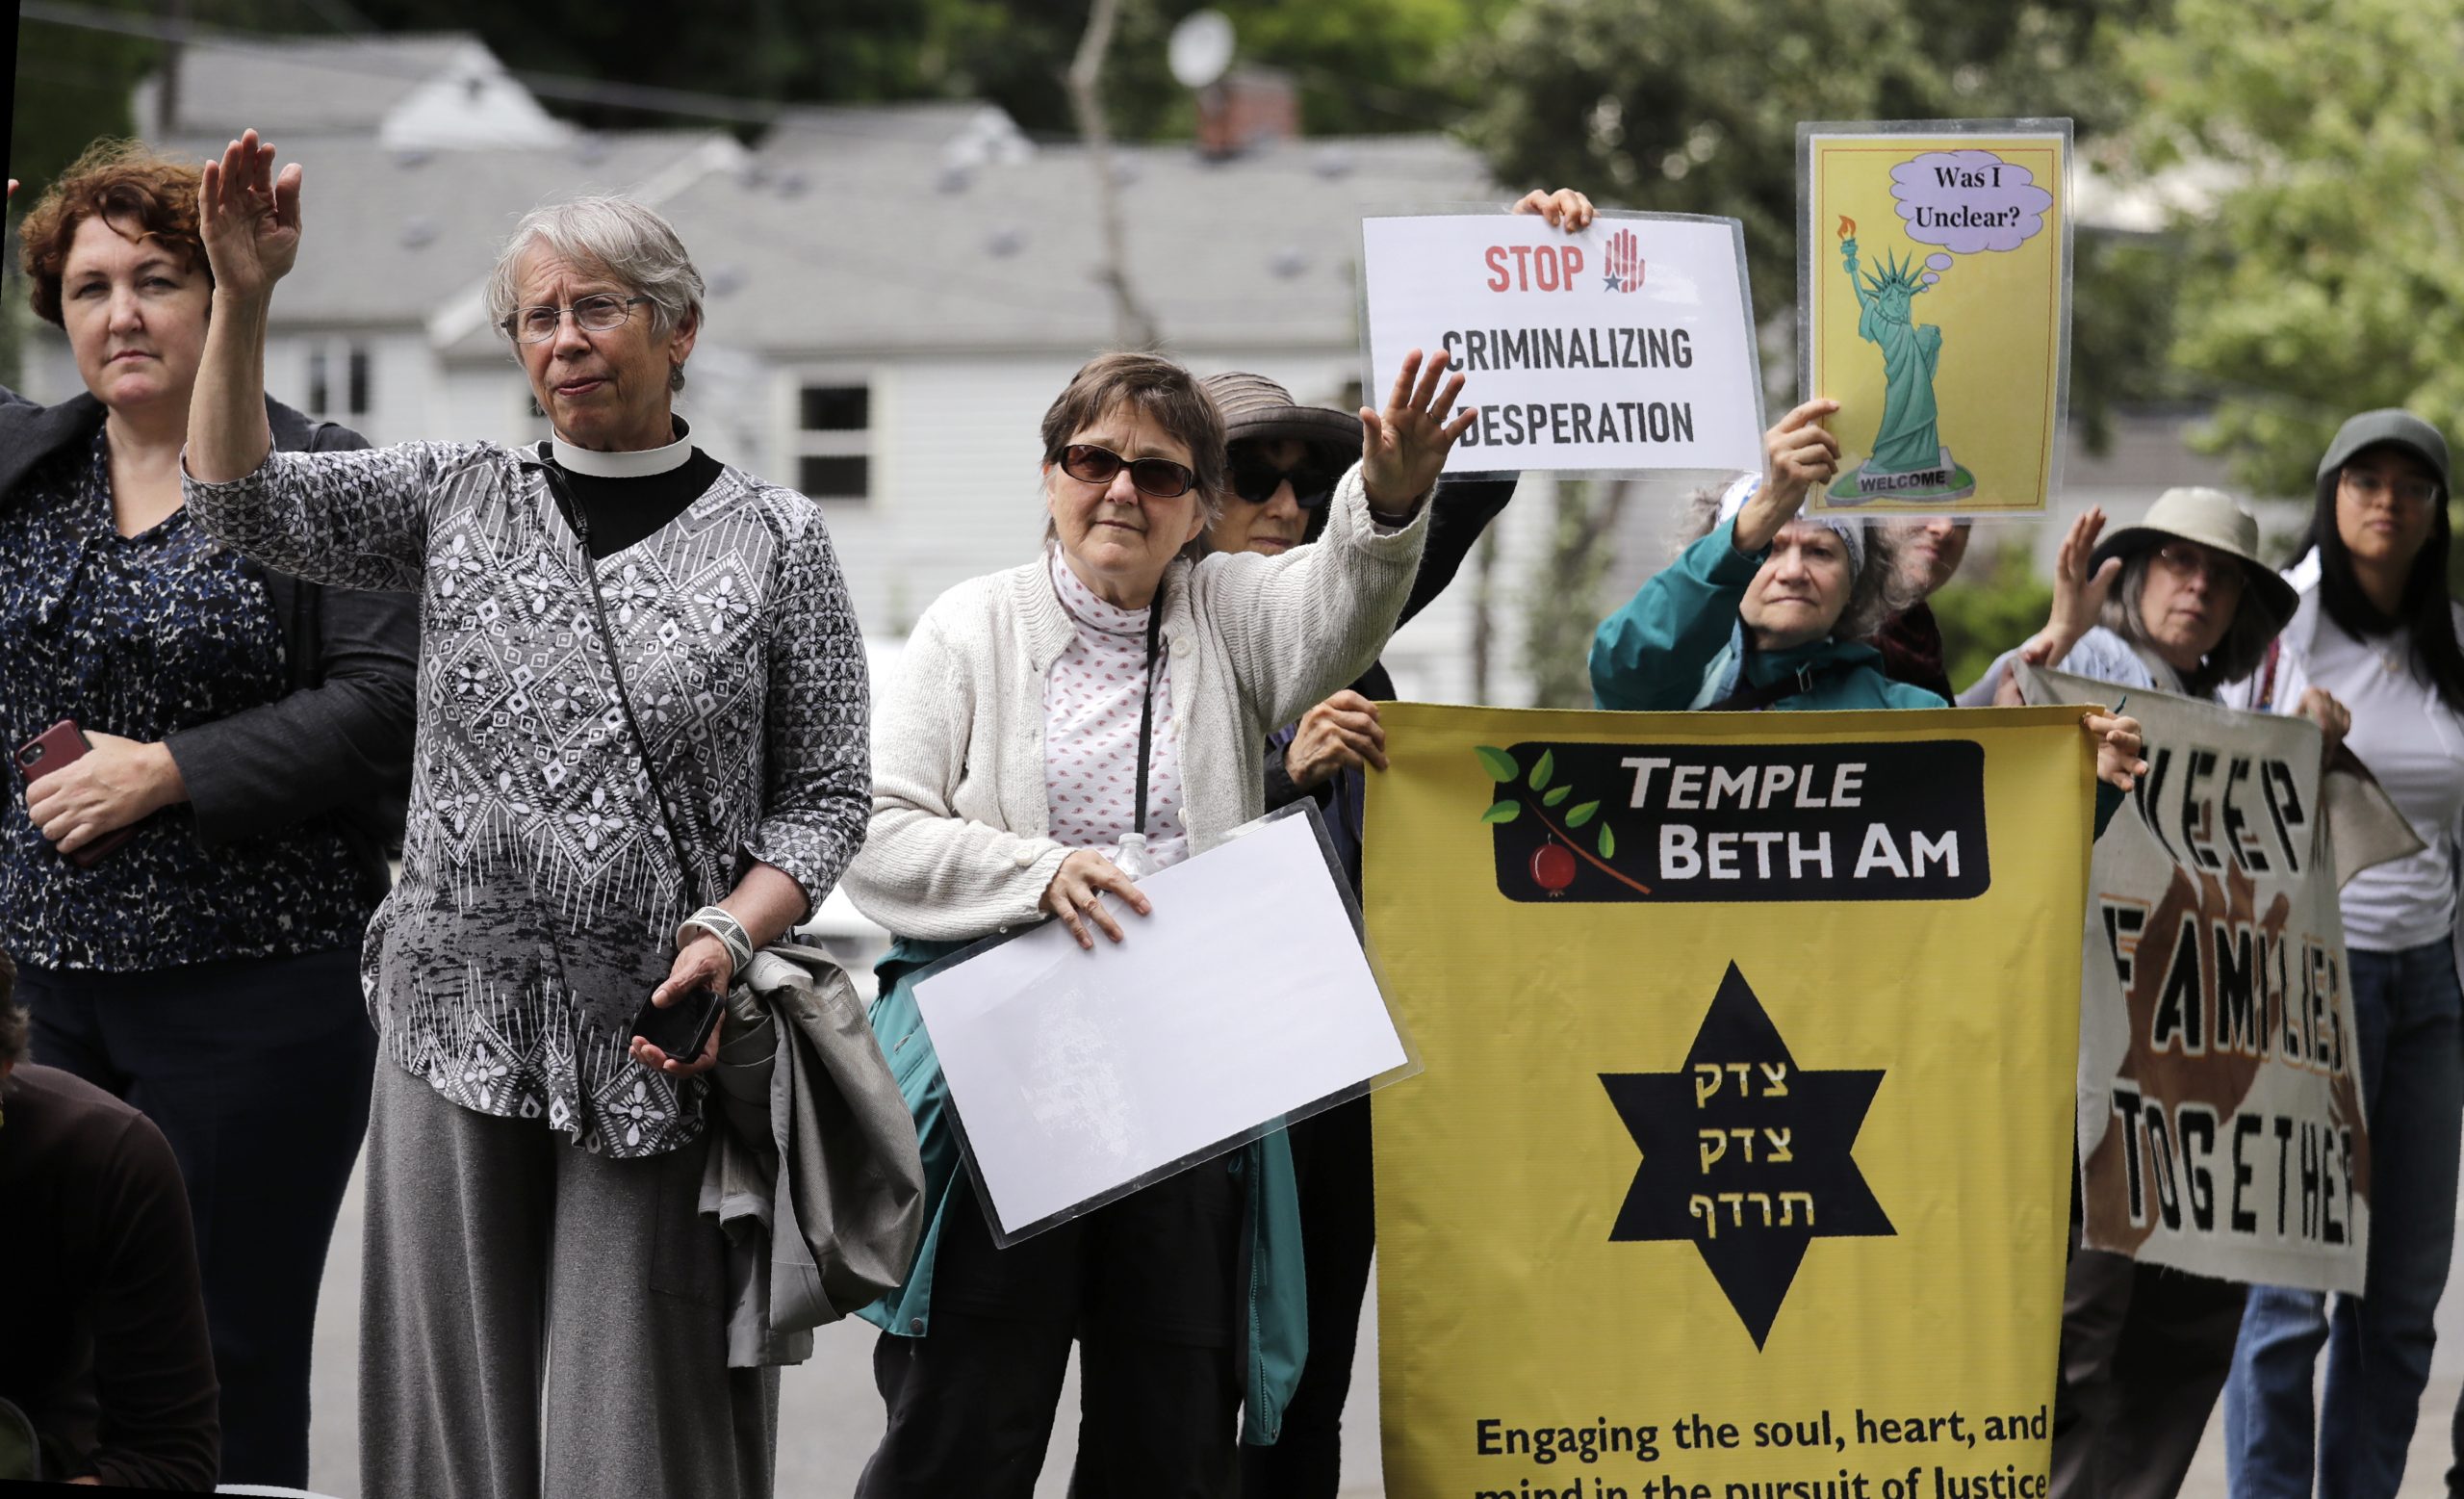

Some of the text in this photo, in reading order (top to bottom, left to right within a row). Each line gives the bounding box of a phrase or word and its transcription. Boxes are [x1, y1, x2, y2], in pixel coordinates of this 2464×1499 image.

[1934, 166, 2001, 190] Was I
[1915, 204, 2020, 228] Unclear?
[1485, 245, 1584, 293] STOP
[1443, 327, 1694, 372] CRIMINALIZING
[1457, 401, 1694, 448] DESPERATION
[1861, 470, 1946, 493] WELCOME
[1621, 757, 1867, 811] TEMPLE
[1693, 1062, 1789, 1109] צדק
[1698, 1127, 1793, 1175] צדק
[1689, 1192, 1814, 1239] תרדף
[1476, 1405, 2048, 1464] Engaging the soul, heart, and
[1882, 1466, 1923, 1499] of
